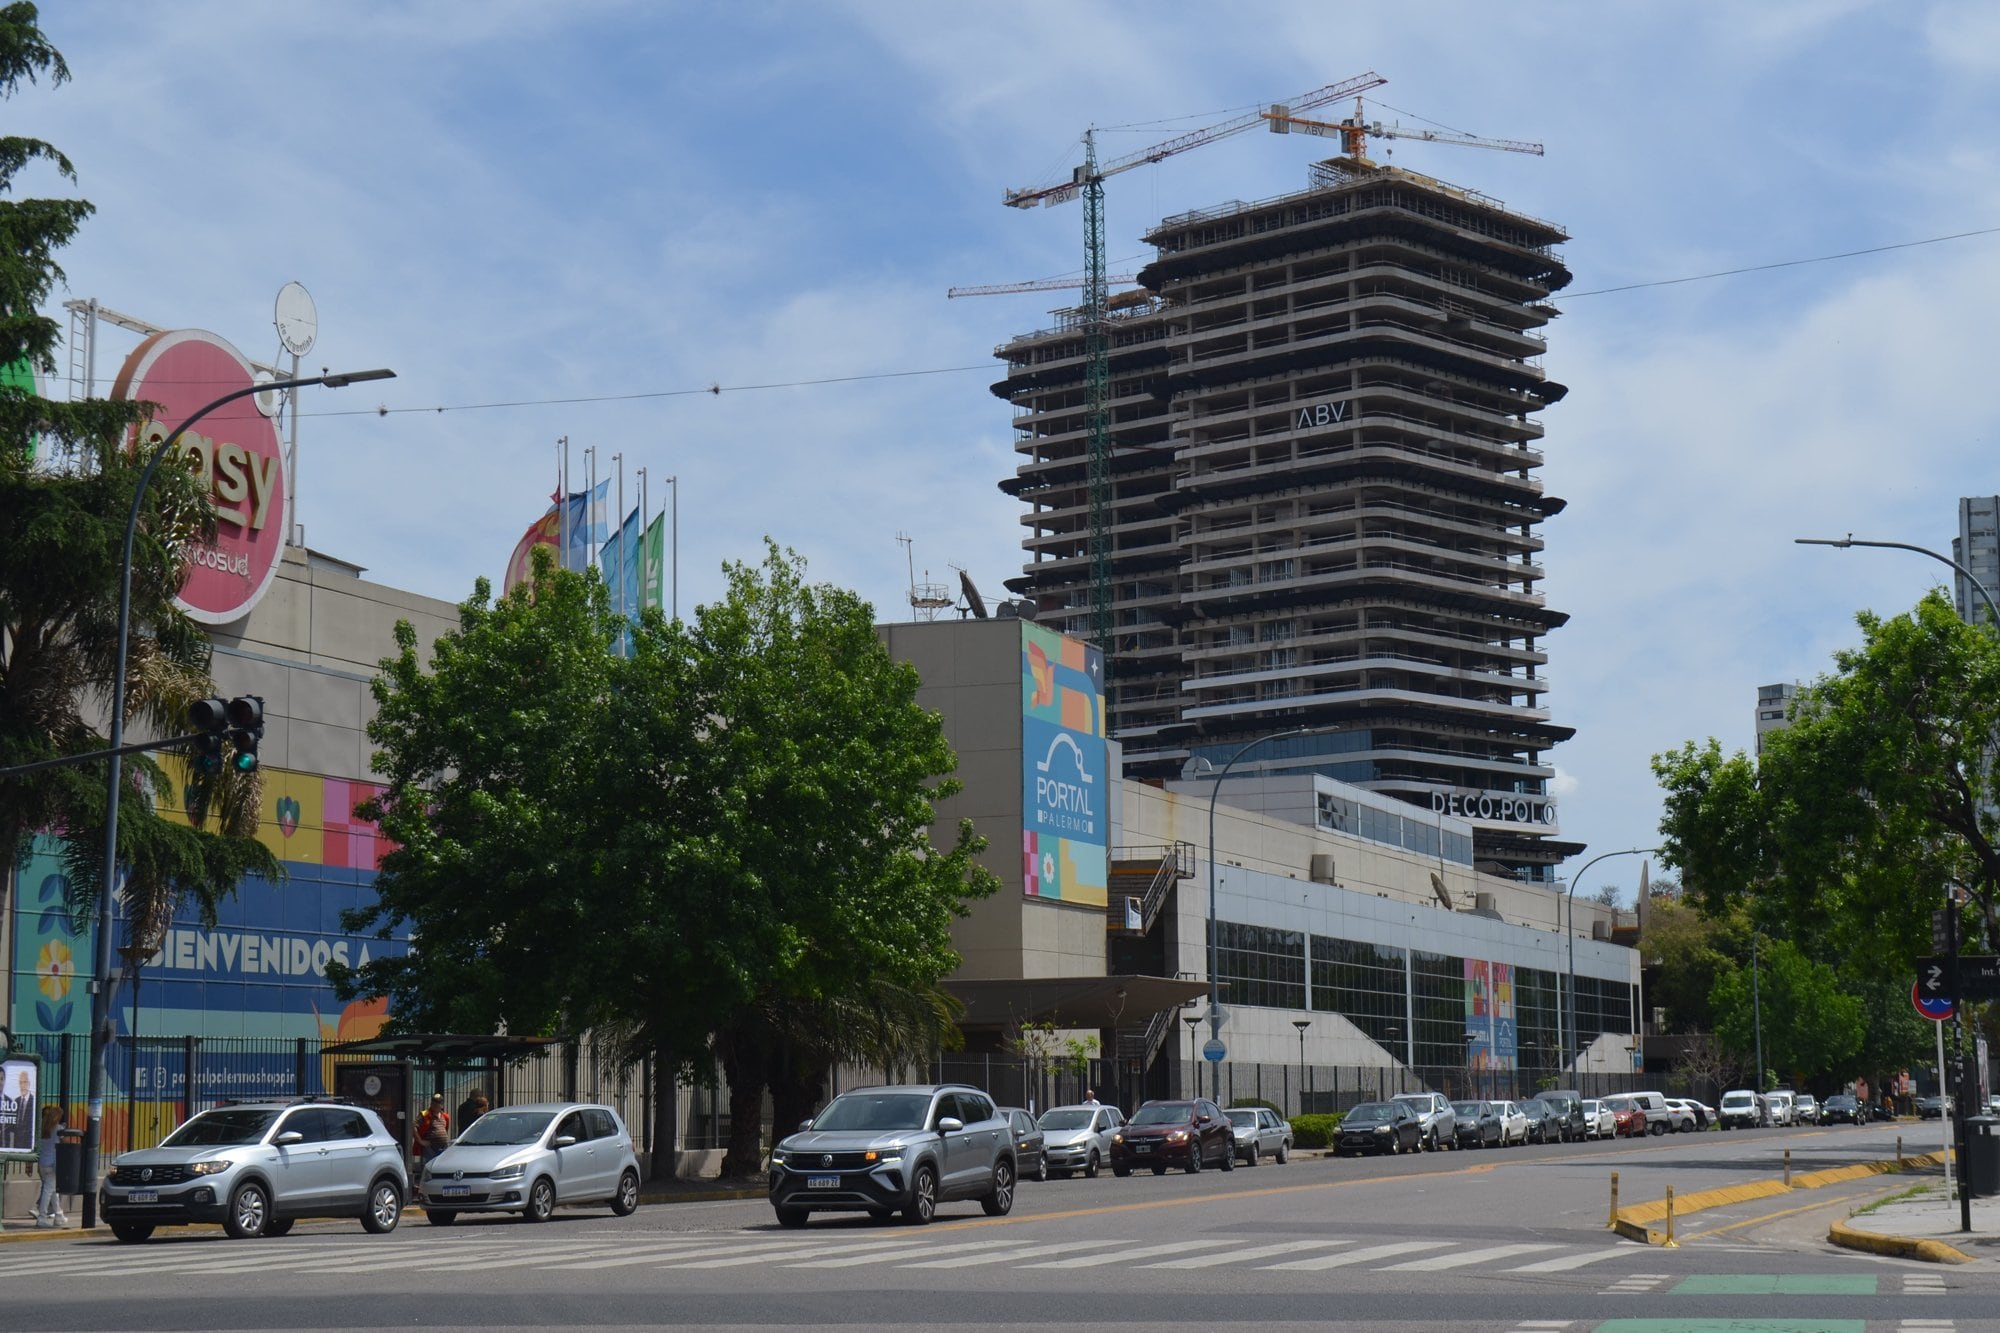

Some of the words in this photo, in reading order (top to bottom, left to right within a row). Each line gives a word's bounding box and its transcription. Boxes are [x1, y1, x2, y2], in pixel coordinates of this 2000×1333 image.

[1305, 126, 1325, 137] ABV
[1052, 190, 1071, 205] ABV
[286, 335, 312, 352] Argentina
[1297, 401, 1345, 429] ABV
[1037, 776, 1093, 816] PORTAL
[1043, 811, 1088, 833] PALERMO
[142, 929, 350, 977] IENVENIDOS
[1981, 967, 1996, 976] Int.
